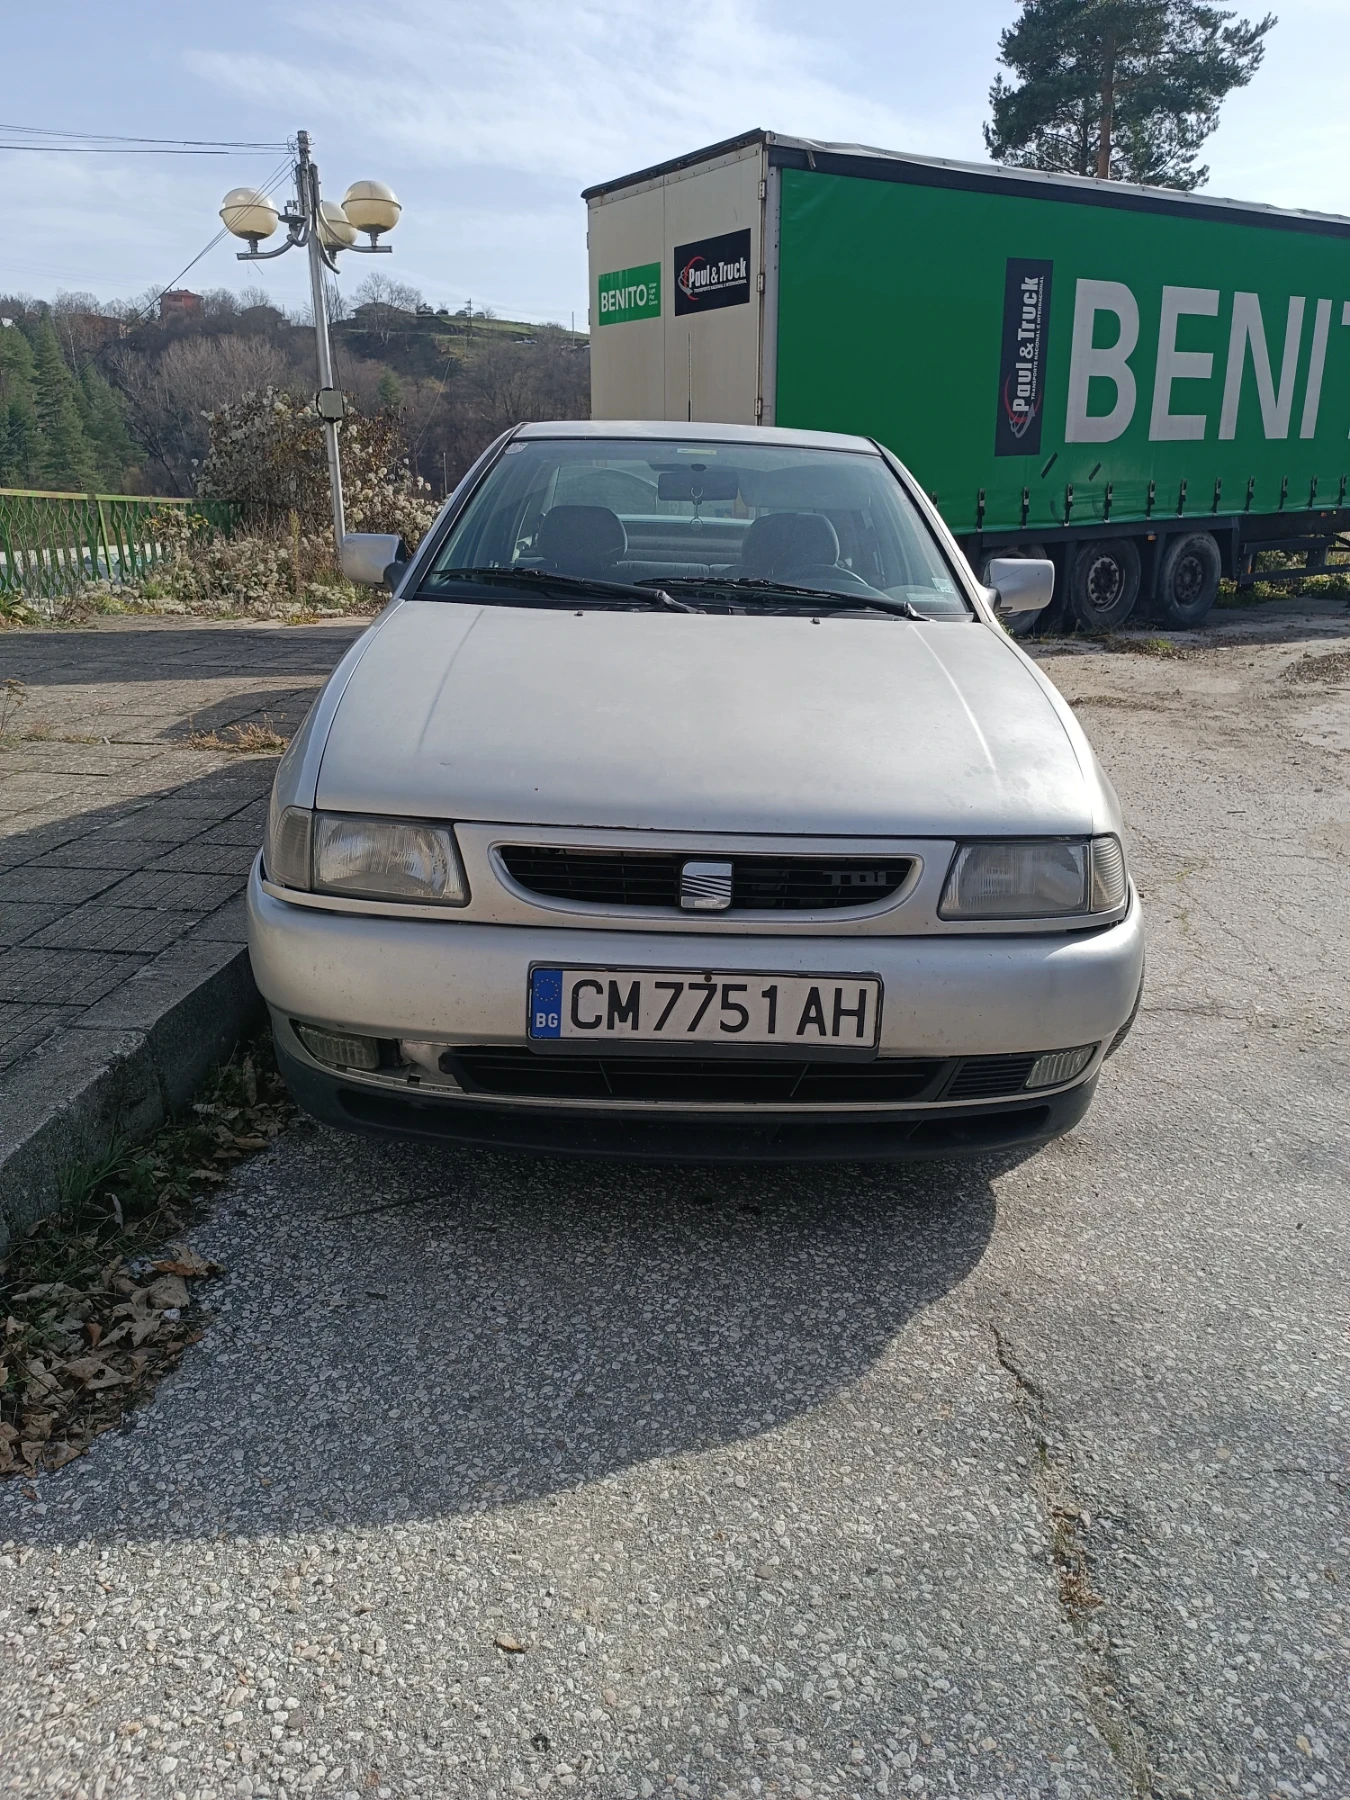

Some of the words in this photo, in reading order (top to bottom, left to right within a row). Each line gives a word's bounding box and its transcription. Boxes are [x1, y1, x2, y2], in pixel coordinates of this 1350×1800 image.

[689, 265, 710, 288] Paul
[711, 267, 719, 284] &
[718, 257, 746, 282] Truck
[601, 284, 648, 313] BENITO
[1017, 276, 1039, 341] Truck
[1019, 342, 1034, 359] &
[1064, 278, 1350, 443] BENI
[1012, 362, 1033, 412] Paul
[1031, 361, 1039, 401] TRANSPORTE
[535, 1012, 559, 1029] BG
[570, 979, 642, 1031] CM
[653, 981, 779, 1035] 7751
[796, 986, 868, 1038] AH
